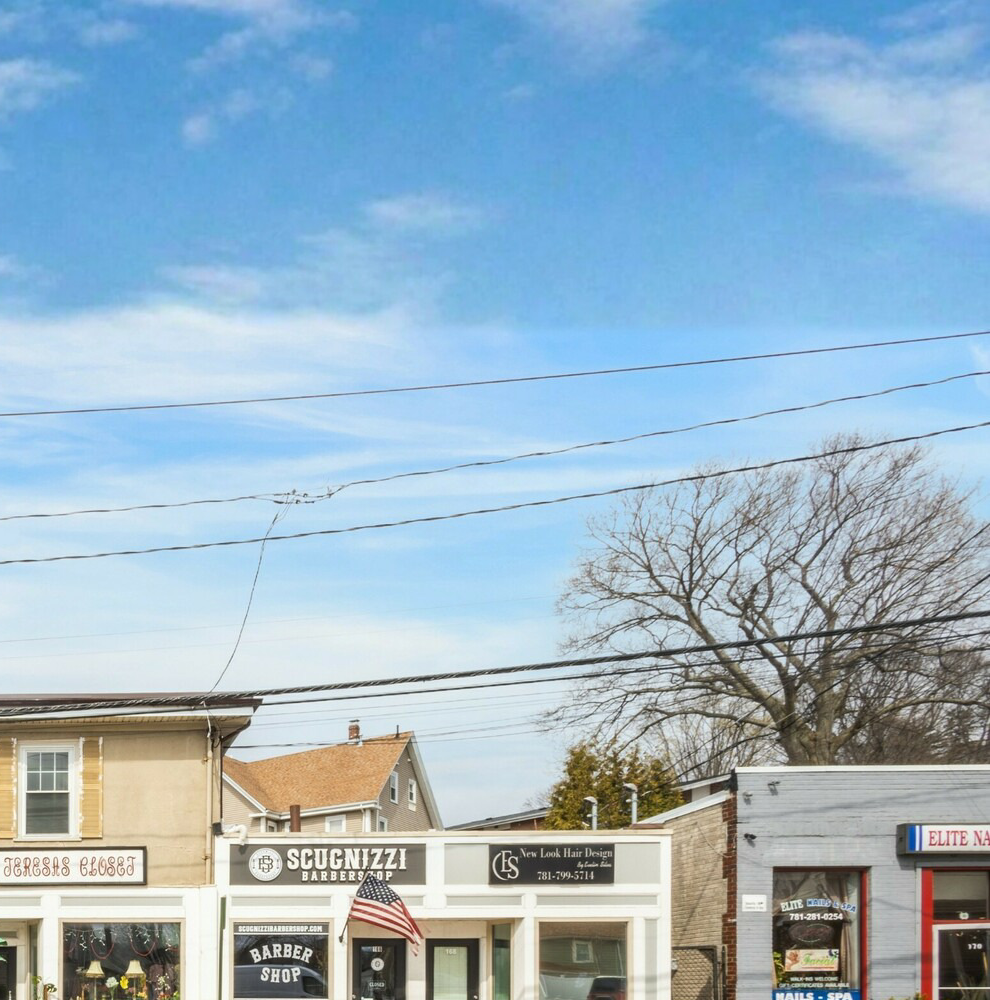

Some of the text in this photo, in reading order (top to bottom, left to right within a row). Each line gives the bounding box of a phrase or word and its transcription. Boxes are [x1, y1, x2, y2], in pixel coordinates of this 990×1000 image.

[928, 830, 968, 846] ELITE
[286, 848, 407, 870] SCUGNIZZI
[520, 848, 613, 860] New Look Hair Design
[4, 856, 136, 877] TERESAS CLOSET
[302, 871, 393, 882] BARBERSOP
[537, 871, 594, 880] 781-799-5714
[780, 900, 804, 912] ELITE
[806, 898, 831, 907] NAILS
[840, 902, 856, 912] SPA
[249, 944, 313, 963] BARBER
[260, 967, 301, 983] SHOP
